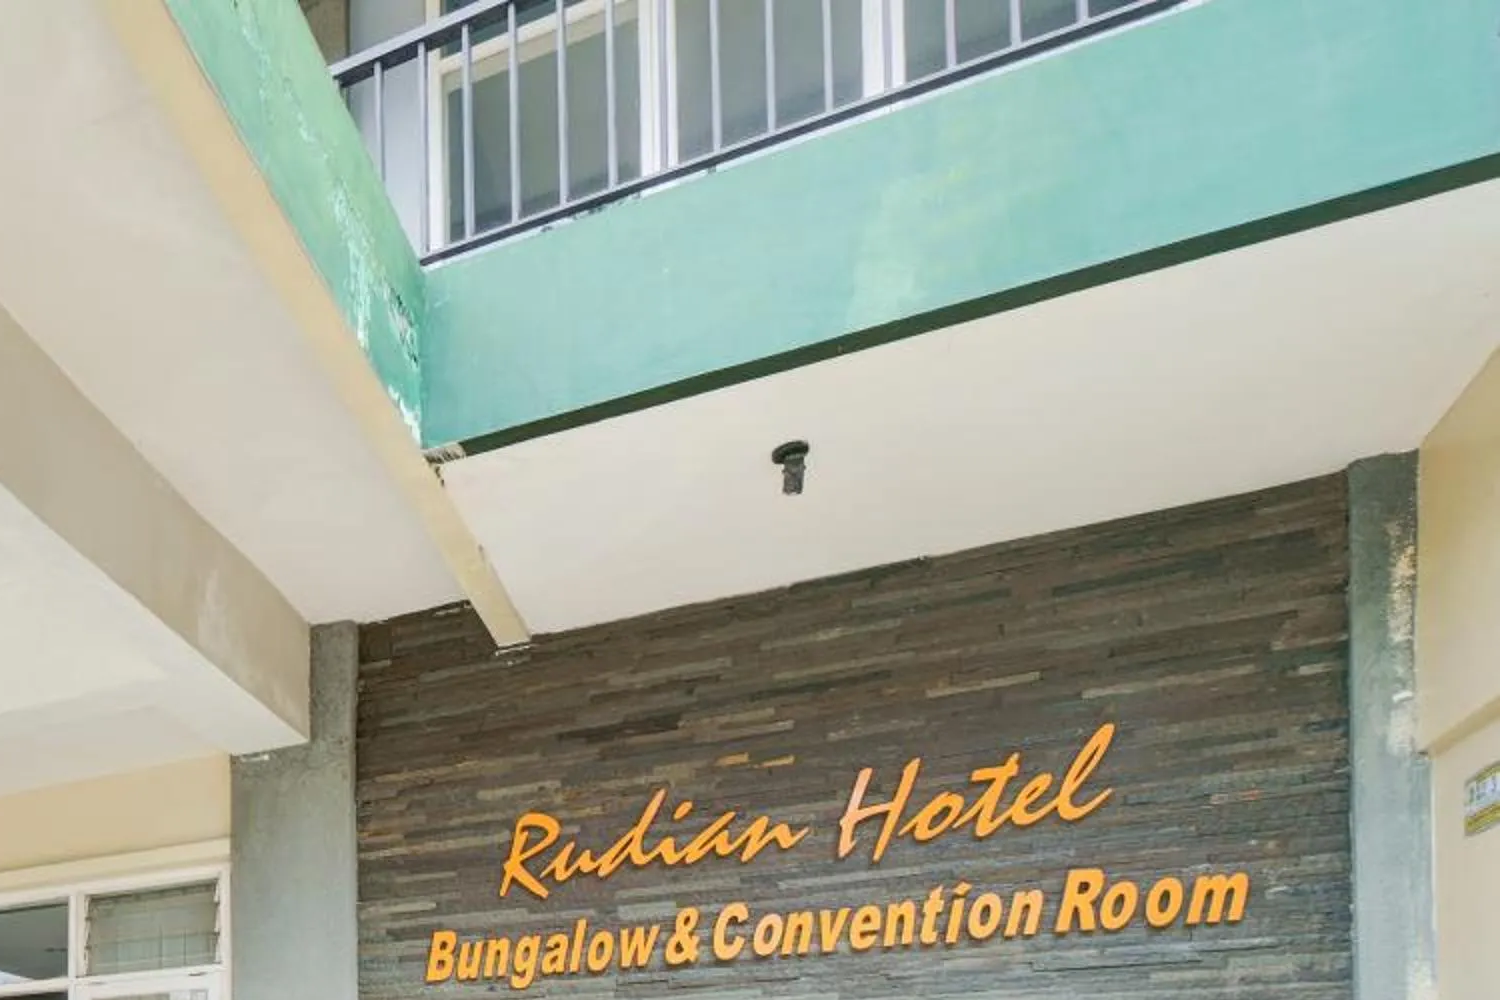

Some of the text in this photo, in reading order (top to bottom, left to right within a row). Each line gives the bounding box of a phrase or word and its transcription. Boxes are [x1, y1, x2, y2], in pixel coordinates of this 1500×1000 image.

[499, 723, 1116, 898] Rudian Hotel
[425, 918, 660, 990] Bungalow
[712, 881, 1044, 961] Convention
[1055, 867, 1250, 934] Room
